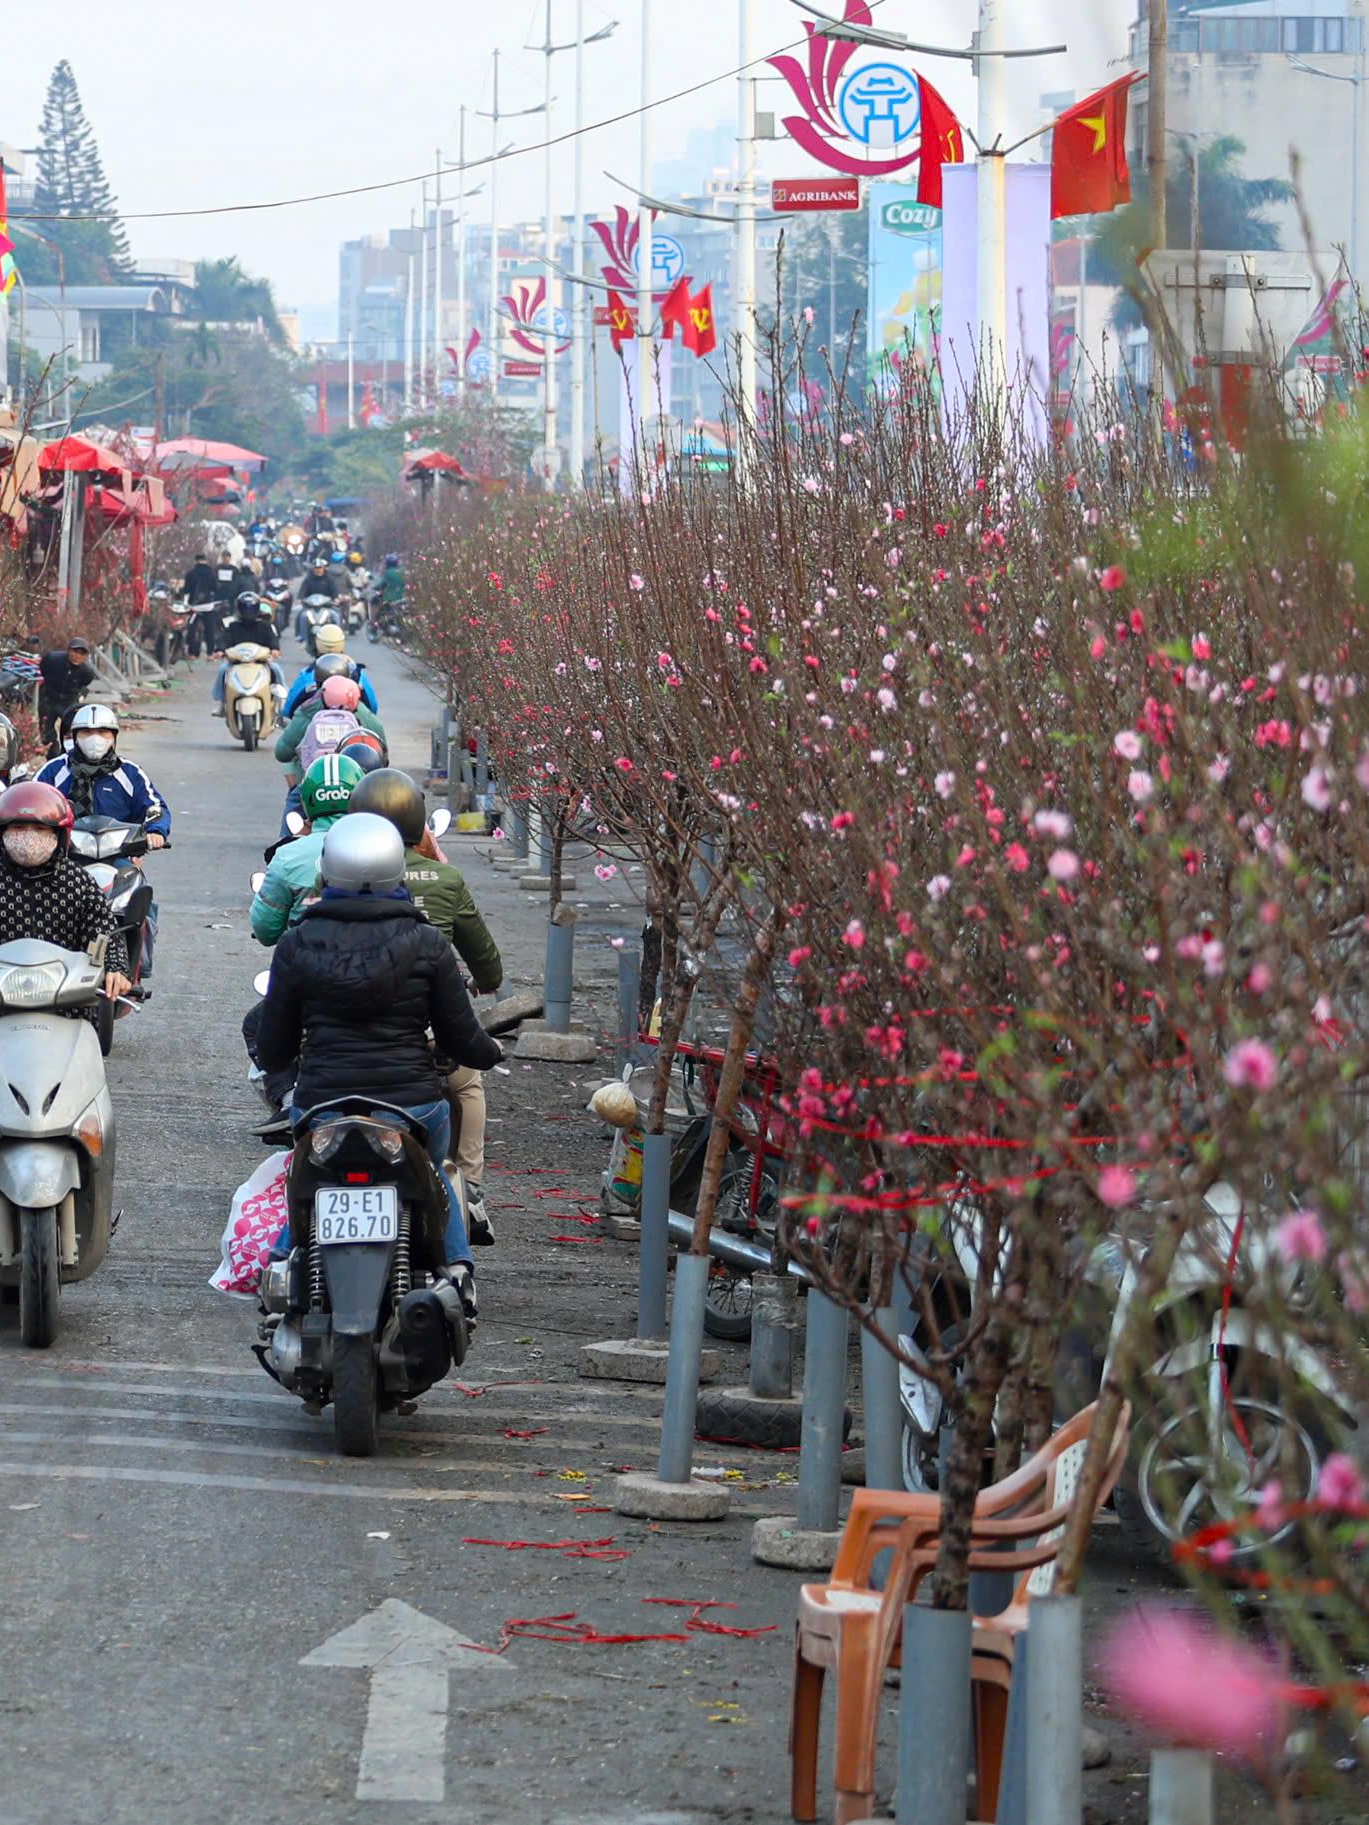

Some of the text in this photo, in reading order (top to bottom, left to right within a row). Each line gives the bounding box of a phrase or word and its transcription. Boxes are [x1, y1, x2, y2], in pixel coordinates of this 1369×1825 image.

[789, 190, 857, 202] AGRIBANK
[886, 204, 938, 228] Cozy
[315, 787, 350, 801] Grab
[328, 1191, 383, 1214] 29-E1
[322, 1215, 391, 1239] 826.70
